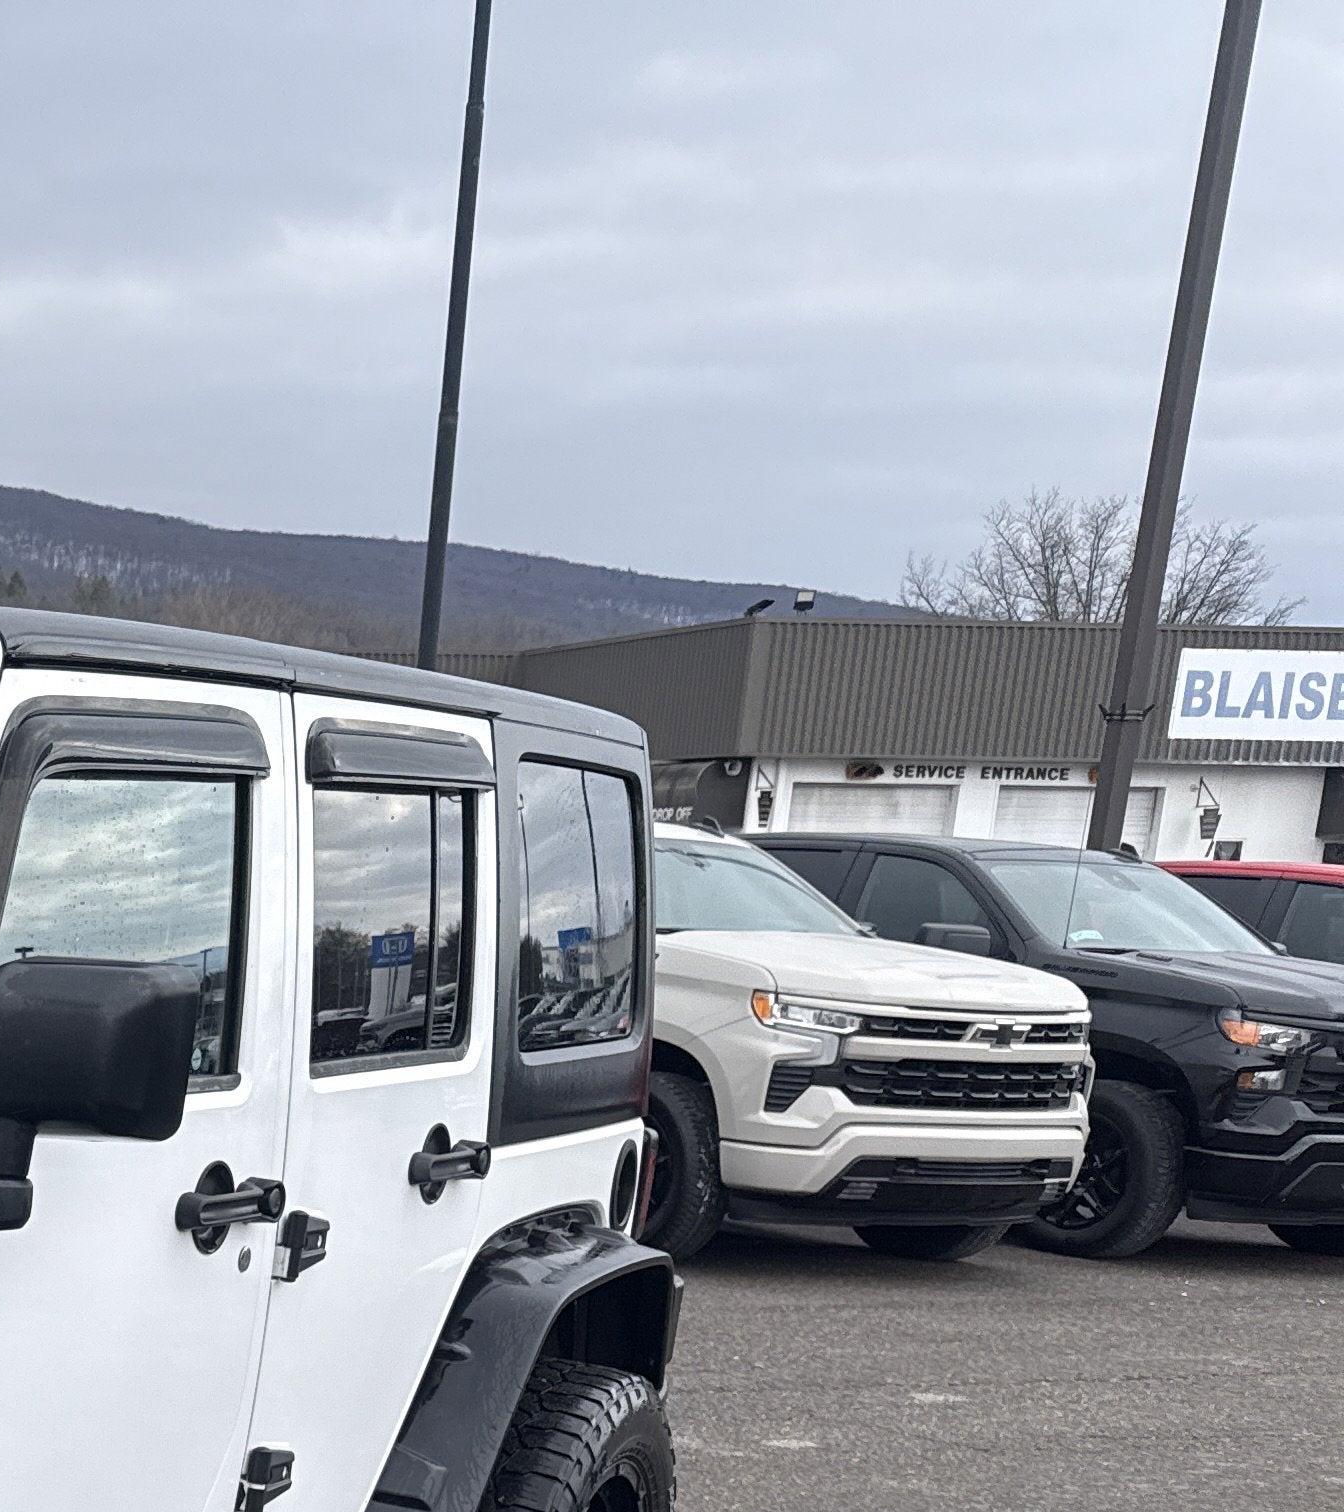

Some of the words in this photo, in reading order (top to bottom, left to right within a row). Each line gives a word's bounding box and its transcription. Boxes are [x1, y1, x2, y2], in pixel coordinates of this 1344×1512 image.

[892, 764, 967, 779] SERVICE
[980, 766, 1071, 780] ENTRANCE
[676, 805, 693, 821] OFF
